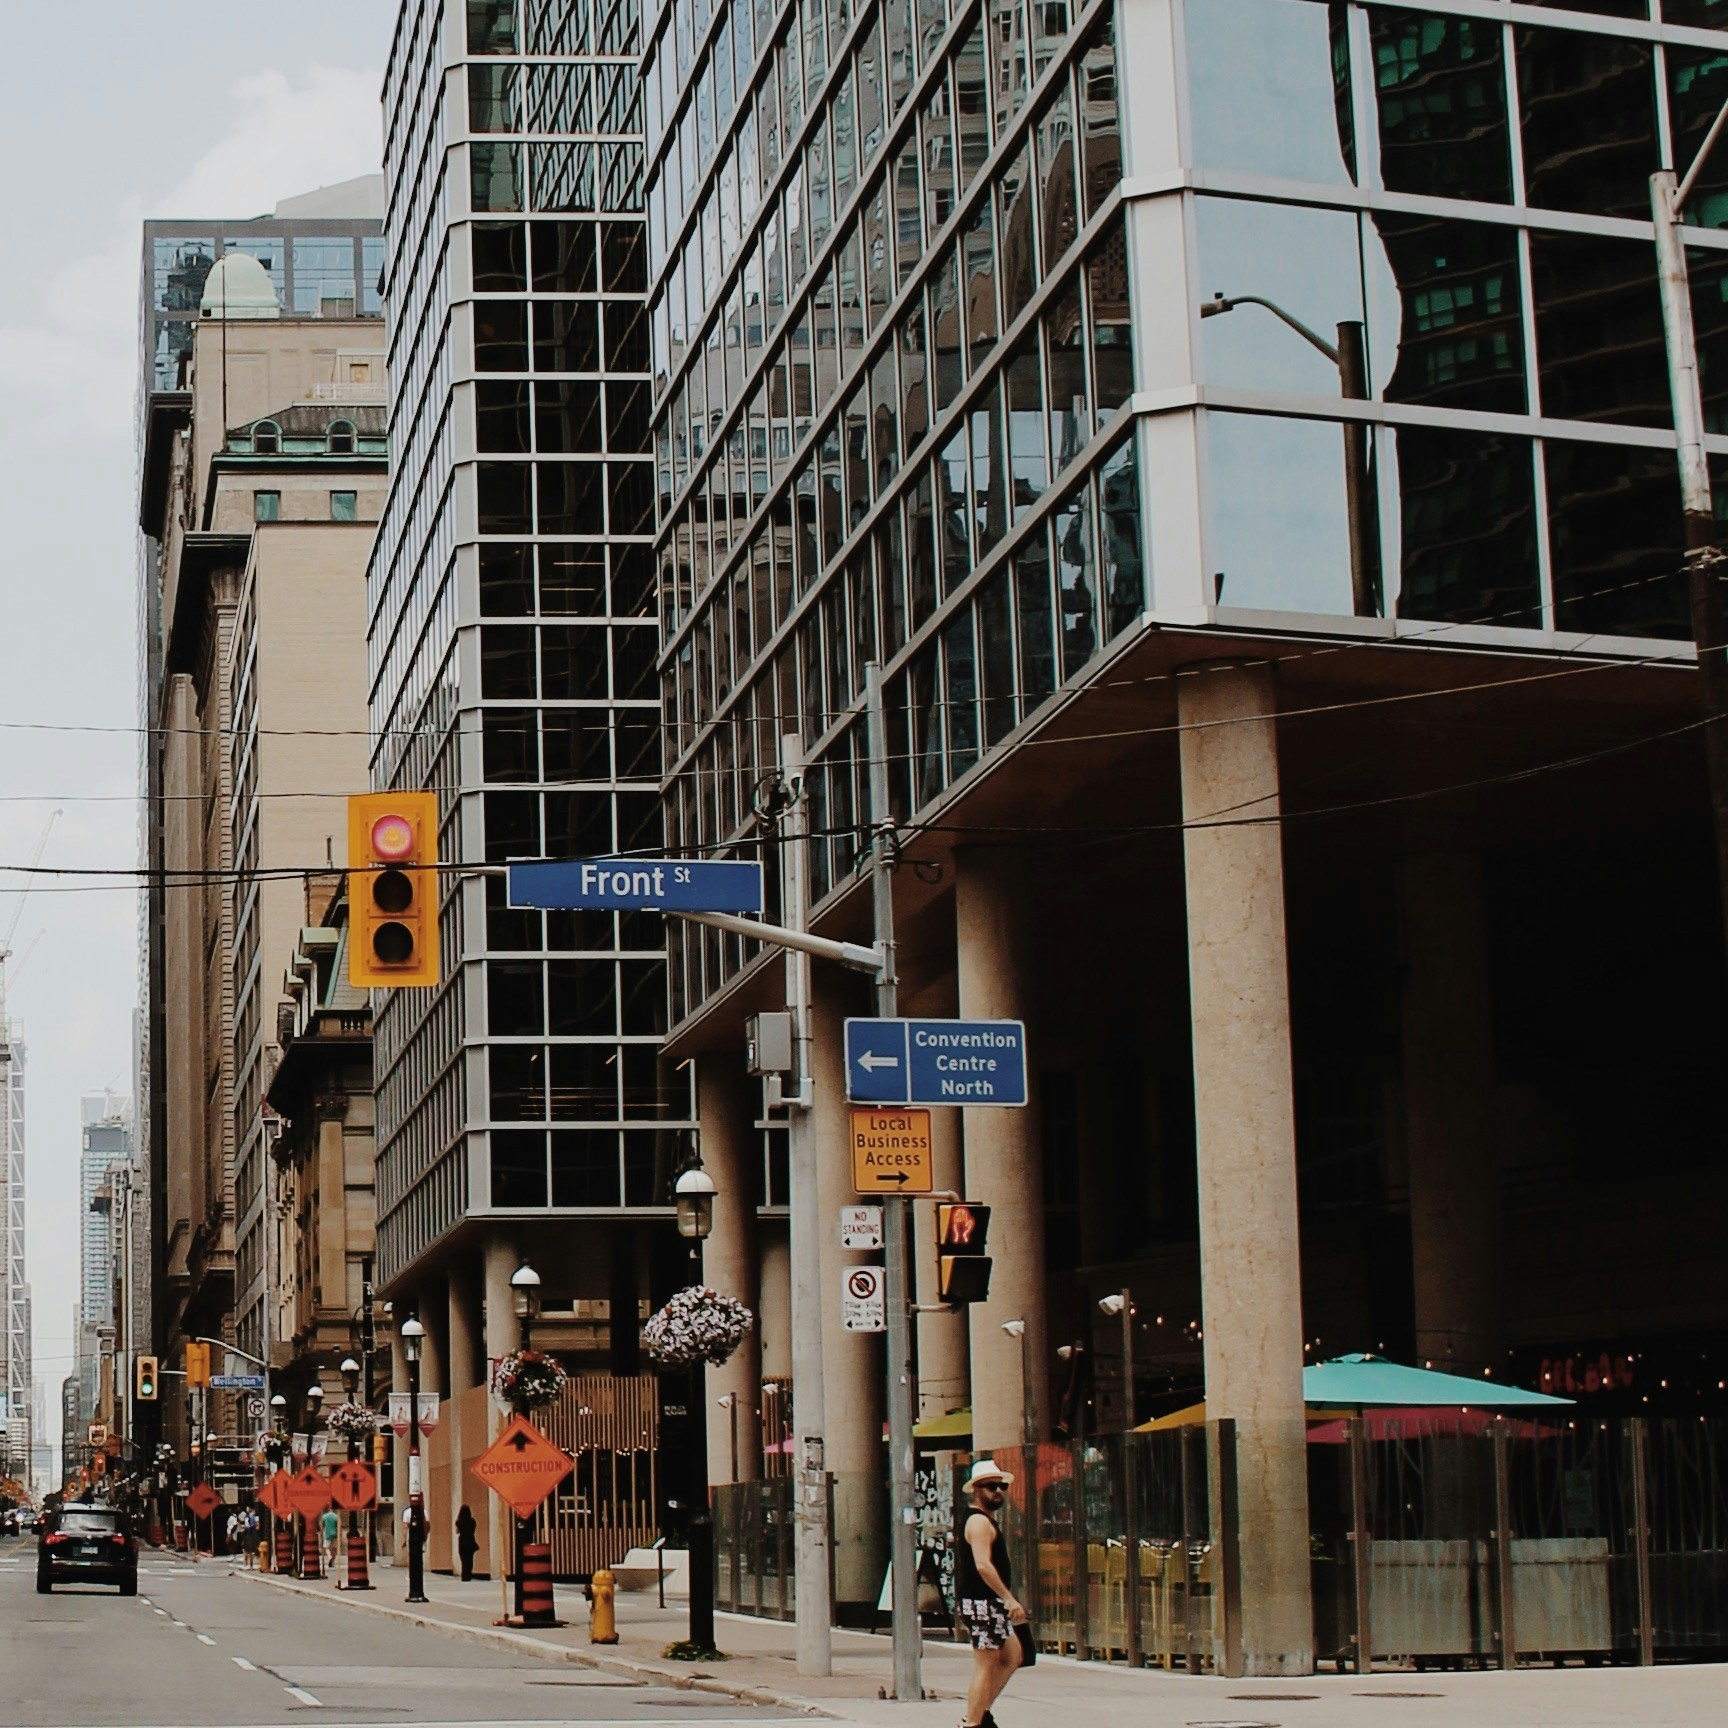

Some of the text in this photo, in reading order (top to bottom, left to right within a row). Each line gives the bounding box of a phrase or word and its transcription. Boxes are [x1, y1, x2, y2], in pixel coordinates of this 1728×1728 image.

[581, 864, 691, 897] Front St
[915, 1031, 1017, 1048] Convention
[936, 1055, 998, 1072] Centre
[941, 1079, 994, 1095] North
[870, 1116, 912, 1131] Local
[857, 1134, 927, 1148] Business
[865, 1152, 921, 1166] Access
[854, 1211, 867, 1222] NO
[843, 1224, 879, 1235] STANDING
[481, 1460, 563, 1475] CONSTRUCTION
